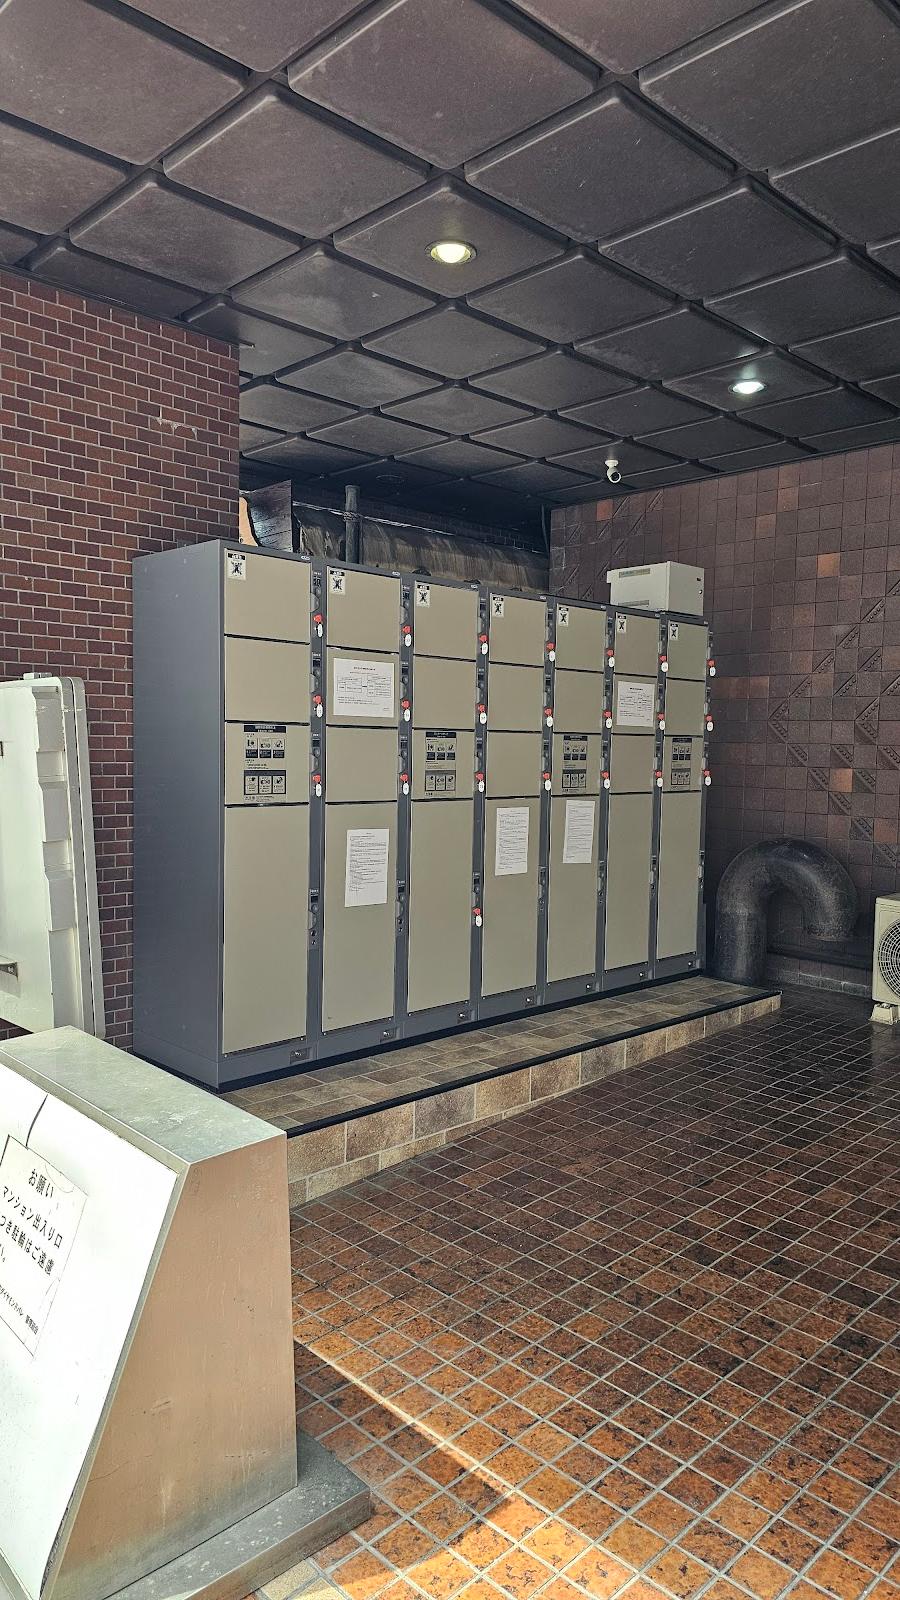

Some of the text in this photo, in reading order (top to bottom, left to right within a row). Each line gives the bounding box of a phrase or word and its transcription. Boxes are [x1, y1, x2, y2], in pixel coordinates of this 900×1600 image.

[28, 1168, 54, 1199] お願い
[3, 1186, 63, 1249] マンション出入り口
